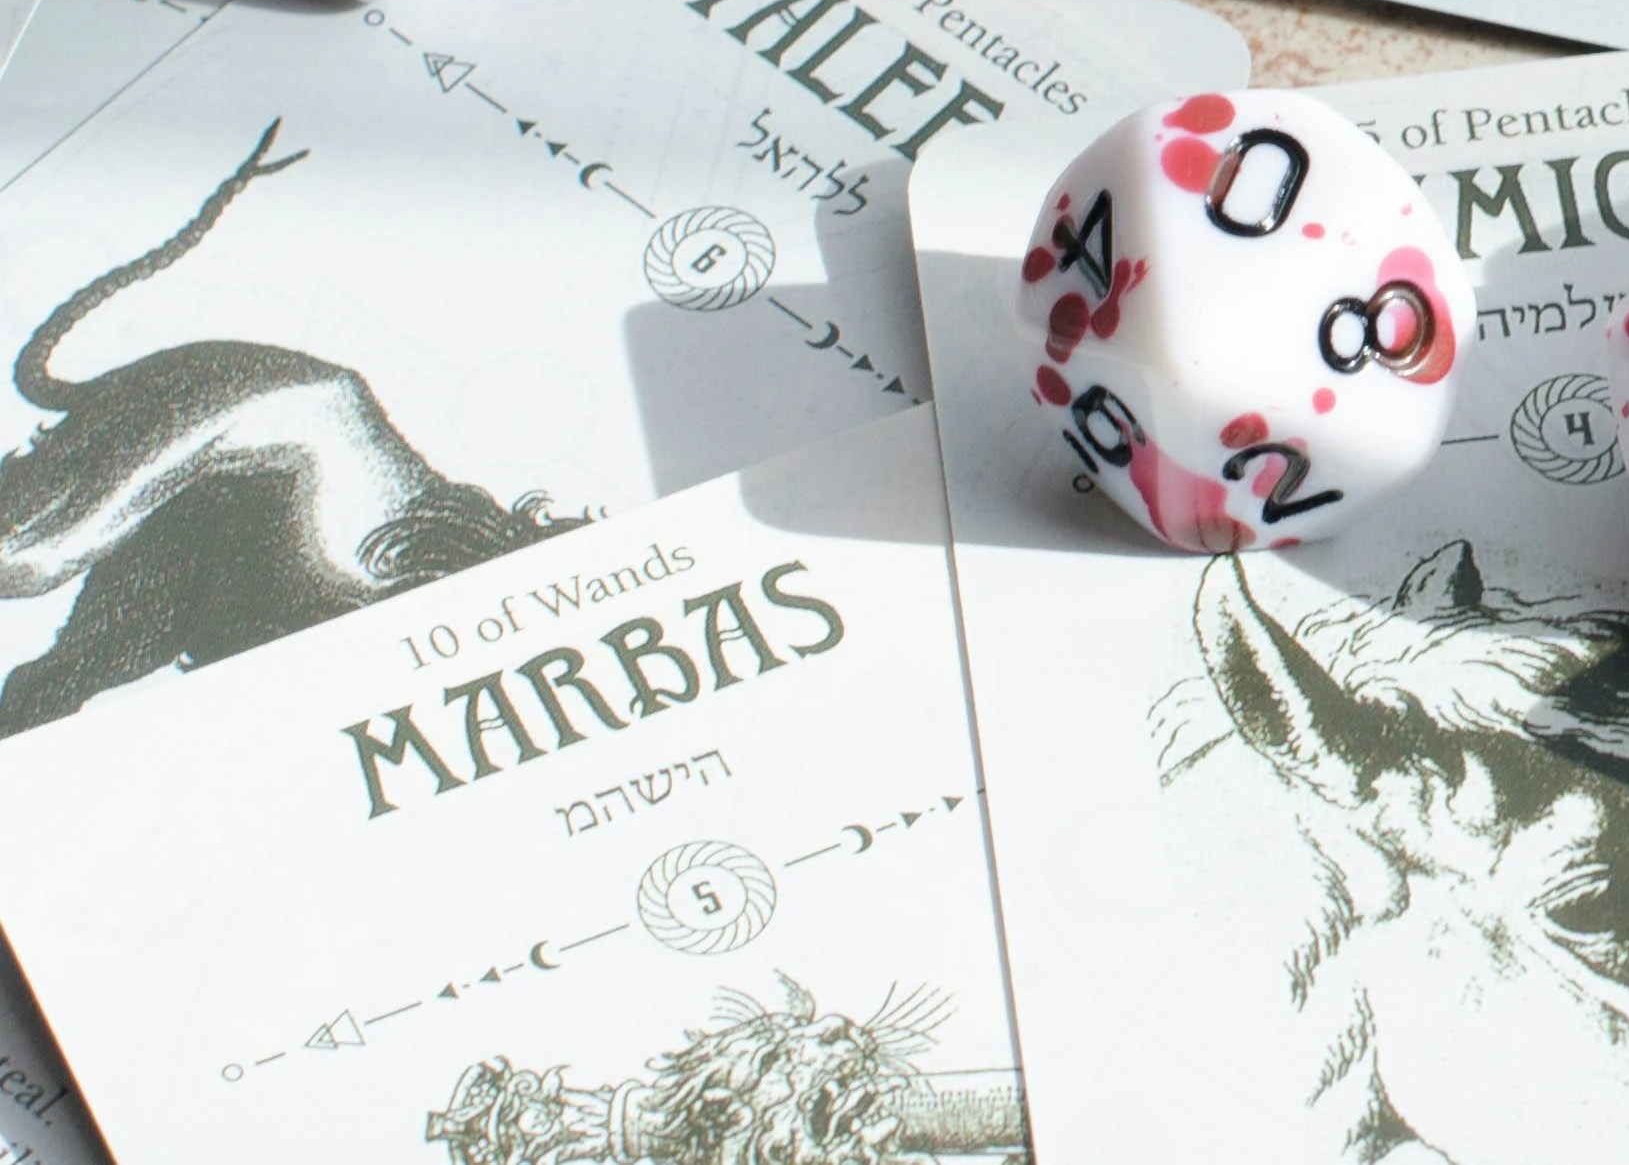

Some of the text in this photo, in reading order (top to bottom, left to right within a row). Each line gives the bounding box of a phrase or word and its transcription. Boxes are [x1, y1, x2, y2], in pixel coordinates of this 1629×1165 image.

[1400, 107, 1449, 151] of
[1317, 278, 1437, 378] 8
[1222, 441, 1344, 524] 2
[400, 541, 698, 672] 10 of Wands
[338, 558, 846, 822] MARBAS
[0, 1055, 71, 1126] eal.
